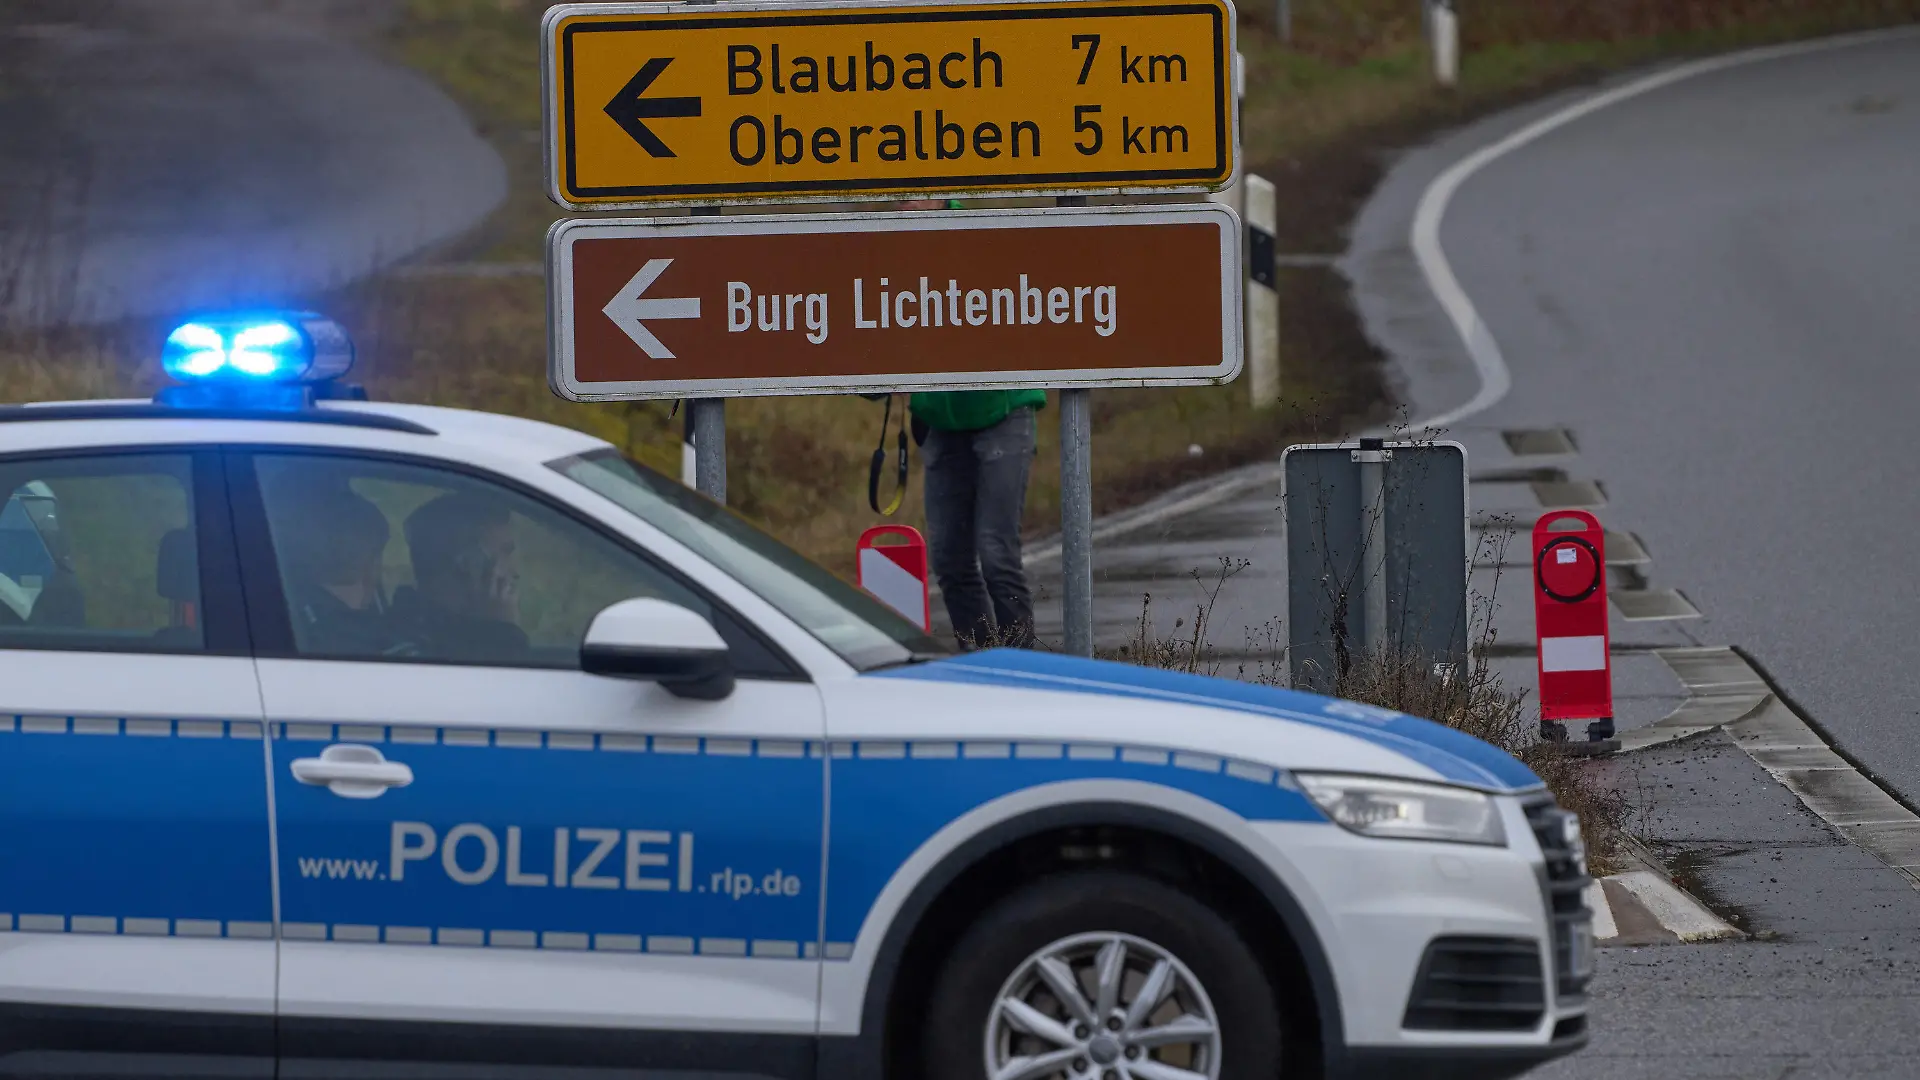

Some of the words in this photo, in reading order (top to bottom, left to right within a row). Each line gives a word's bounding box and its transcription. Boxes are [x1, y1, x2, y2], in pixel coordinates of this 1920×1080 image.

[728, 38, 1003, 95] Blaubach
[1072, 34, 1101, 85] 7
[1120, 46, 1187, 84] km
[729, 110, 1040, 166] Oberalben
[1074, 105, 1102, 155] 5
[1122, 116, 1189, 154] km
[727, 281, 828, 344] Burg
[854, 274, 1117, 337] Lichtenberg
